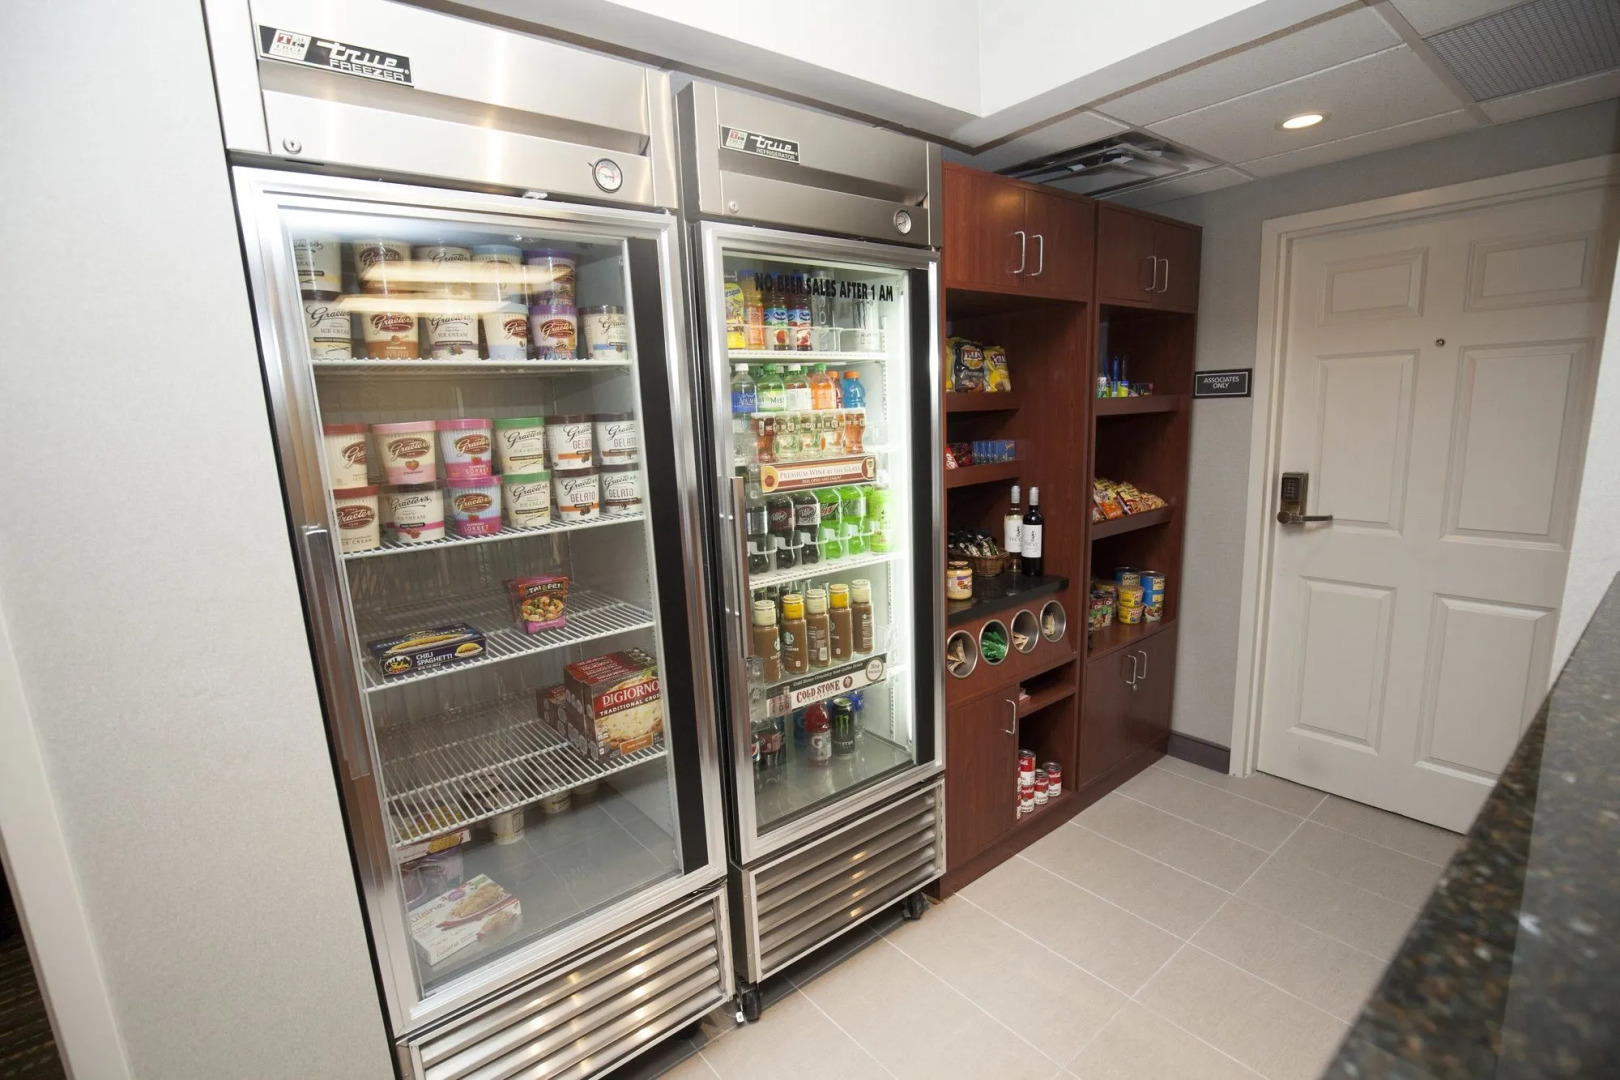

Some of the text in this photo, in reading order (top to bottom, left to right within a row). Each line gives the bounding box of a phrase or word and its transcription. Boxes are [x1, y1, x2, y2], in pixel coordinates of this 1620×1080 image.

[329, 59, 404, 81] FREEZER
[756, 148, 795, 160] REFRIGERATOR
[755, 272, 772, 292] NO
[806, 278, 836, 297] SALES
[840, 281, 868, 299] AFTER
[871, 285, 875, 300] 1
[879, 285, 893, 302] AM
[1203, 376, 1240, 384] ASSOCIATES
[780, 470, 809, 480] PREMIUM
[844, 465, 860, 473] GLASS
[570, 491, 596, 503] GELATO
[609, 488, 633, 498] GELATO
[416, 652, 433, 660] CHILI
[416, 653, 453, 666] SPAGHETTI
[602, 680, 659, 706] DIGIORNO
[797, 689, 816, 703] COLD
[817, 680, 840, 695] STONE
[600, 700, 643, 716] TRADITIONAL
